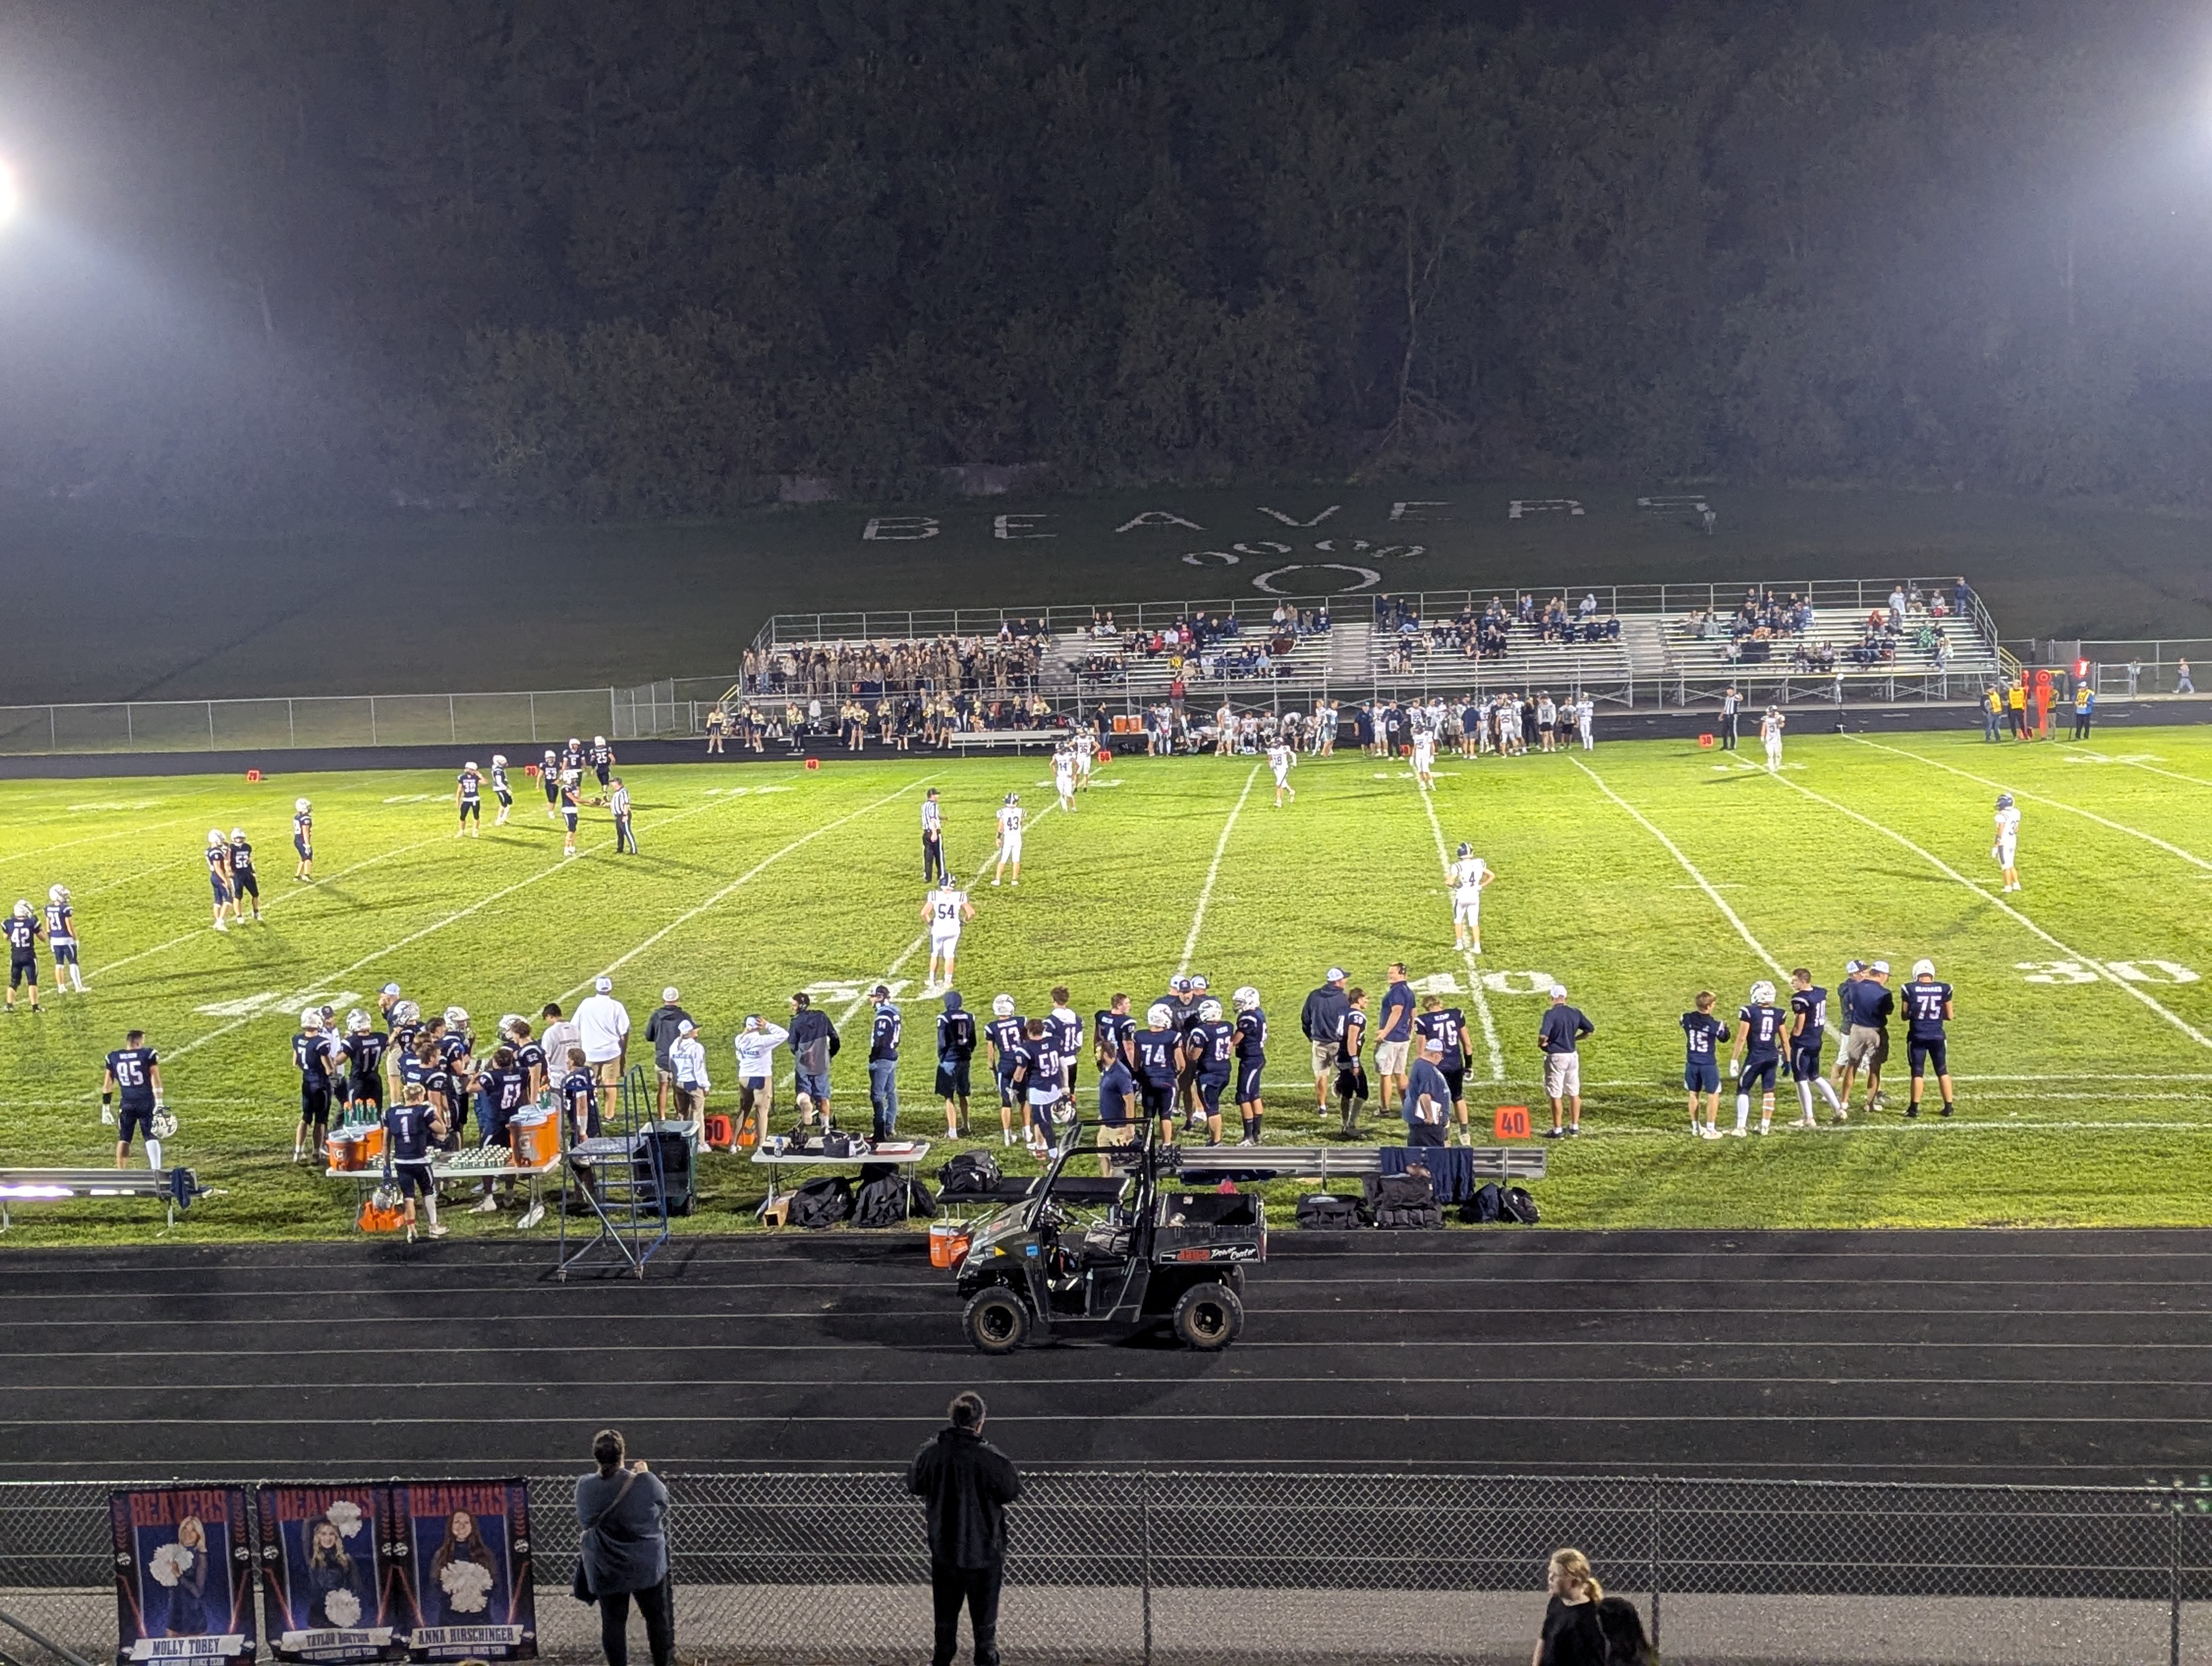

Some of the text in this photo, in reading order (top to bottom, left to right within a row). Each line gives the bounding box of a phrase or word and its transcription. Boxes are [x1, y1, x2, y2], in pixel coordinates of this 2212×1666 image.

[1702, 736, 1711, 745] 30
[596, 752, 607, 764] 25
[1101, 753, 1110, 761] 50
[1007, 816, 1019, 831] 43
[47, 912, 62, 930] 21
[938, 904, 955, 919] 54
[11, 928, 30, 948] 42
[2014, 960, 2200, 984] 30
[1917, 995, 1941, 1020] 75
[957, 1022, 967, 1046] 9
[1000, 1026, 1020, 1052] 13
[1433, 1020, 1457, 1046] 76
[1760, 1016, 1773, 1041] 0
[298, 1047, 309, 1070] 7
[362, 1046, 382, 1072] 17
[1038, 1051, 1058, 1077] 50
[1141, 1044, 1166, 1068] 74
[400, 1116, 410, 1144] 1
[705, 1118, 724, 1142] 50
[1501, 1112, 1525, 1135] 40
[128, 1490, 228, 1527] BEAVERS
[410, 1483, 508, 1517] BEAVERS
[153, 1638, 220, 1656] MOLLY TOBEY
[306, 1632, 336, 1647] TAYLOR
[418, 1627, 514, 1644] ANNA HIRSCHINGER
